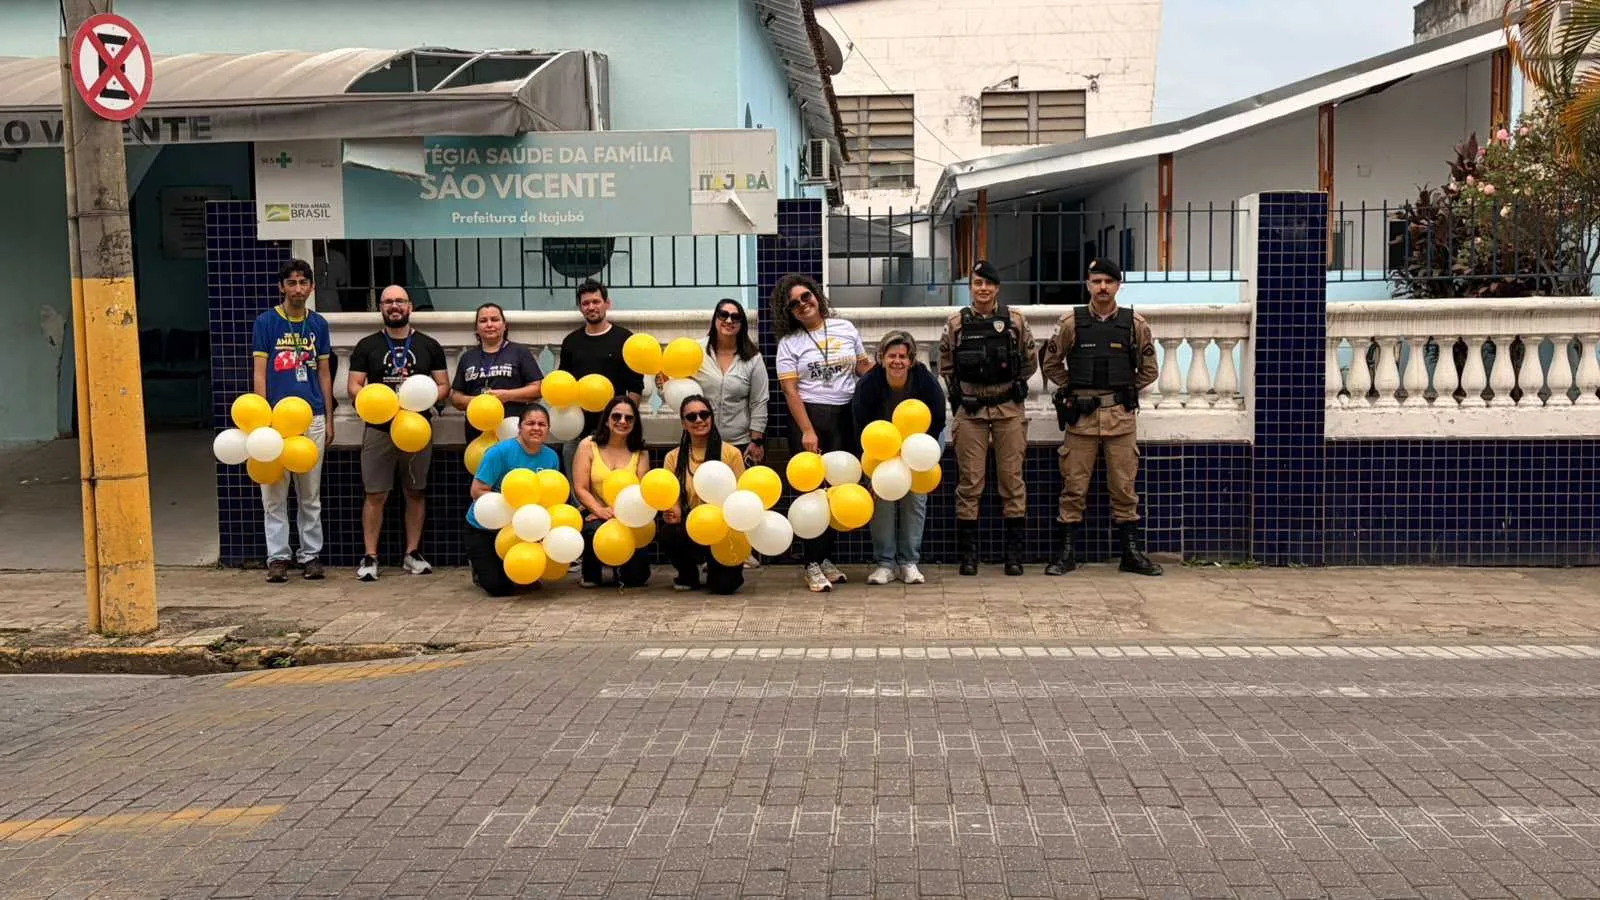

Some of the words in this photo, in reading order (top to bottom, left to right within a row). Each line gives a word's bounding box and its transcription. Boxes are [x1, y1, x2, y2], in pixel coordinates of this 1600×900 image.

[0, 119, 31, 145] O
[40, 116, 212, 144] VNTE
[486, 143, 553, 165] SAÚDE
[559, 147, 588, 164] DA
[593, 141, 674, 164] FAMÍLIA
[420, 166, 486, 200] SÃO
[490, 172, 616, 200] VICENTE
[290, 208, 331, 219] BRASIL
[451, 210, 518, 225] Prefeitura
[519, 210, 536, 224] de
[538, 209, 585, 226] Itajubá
